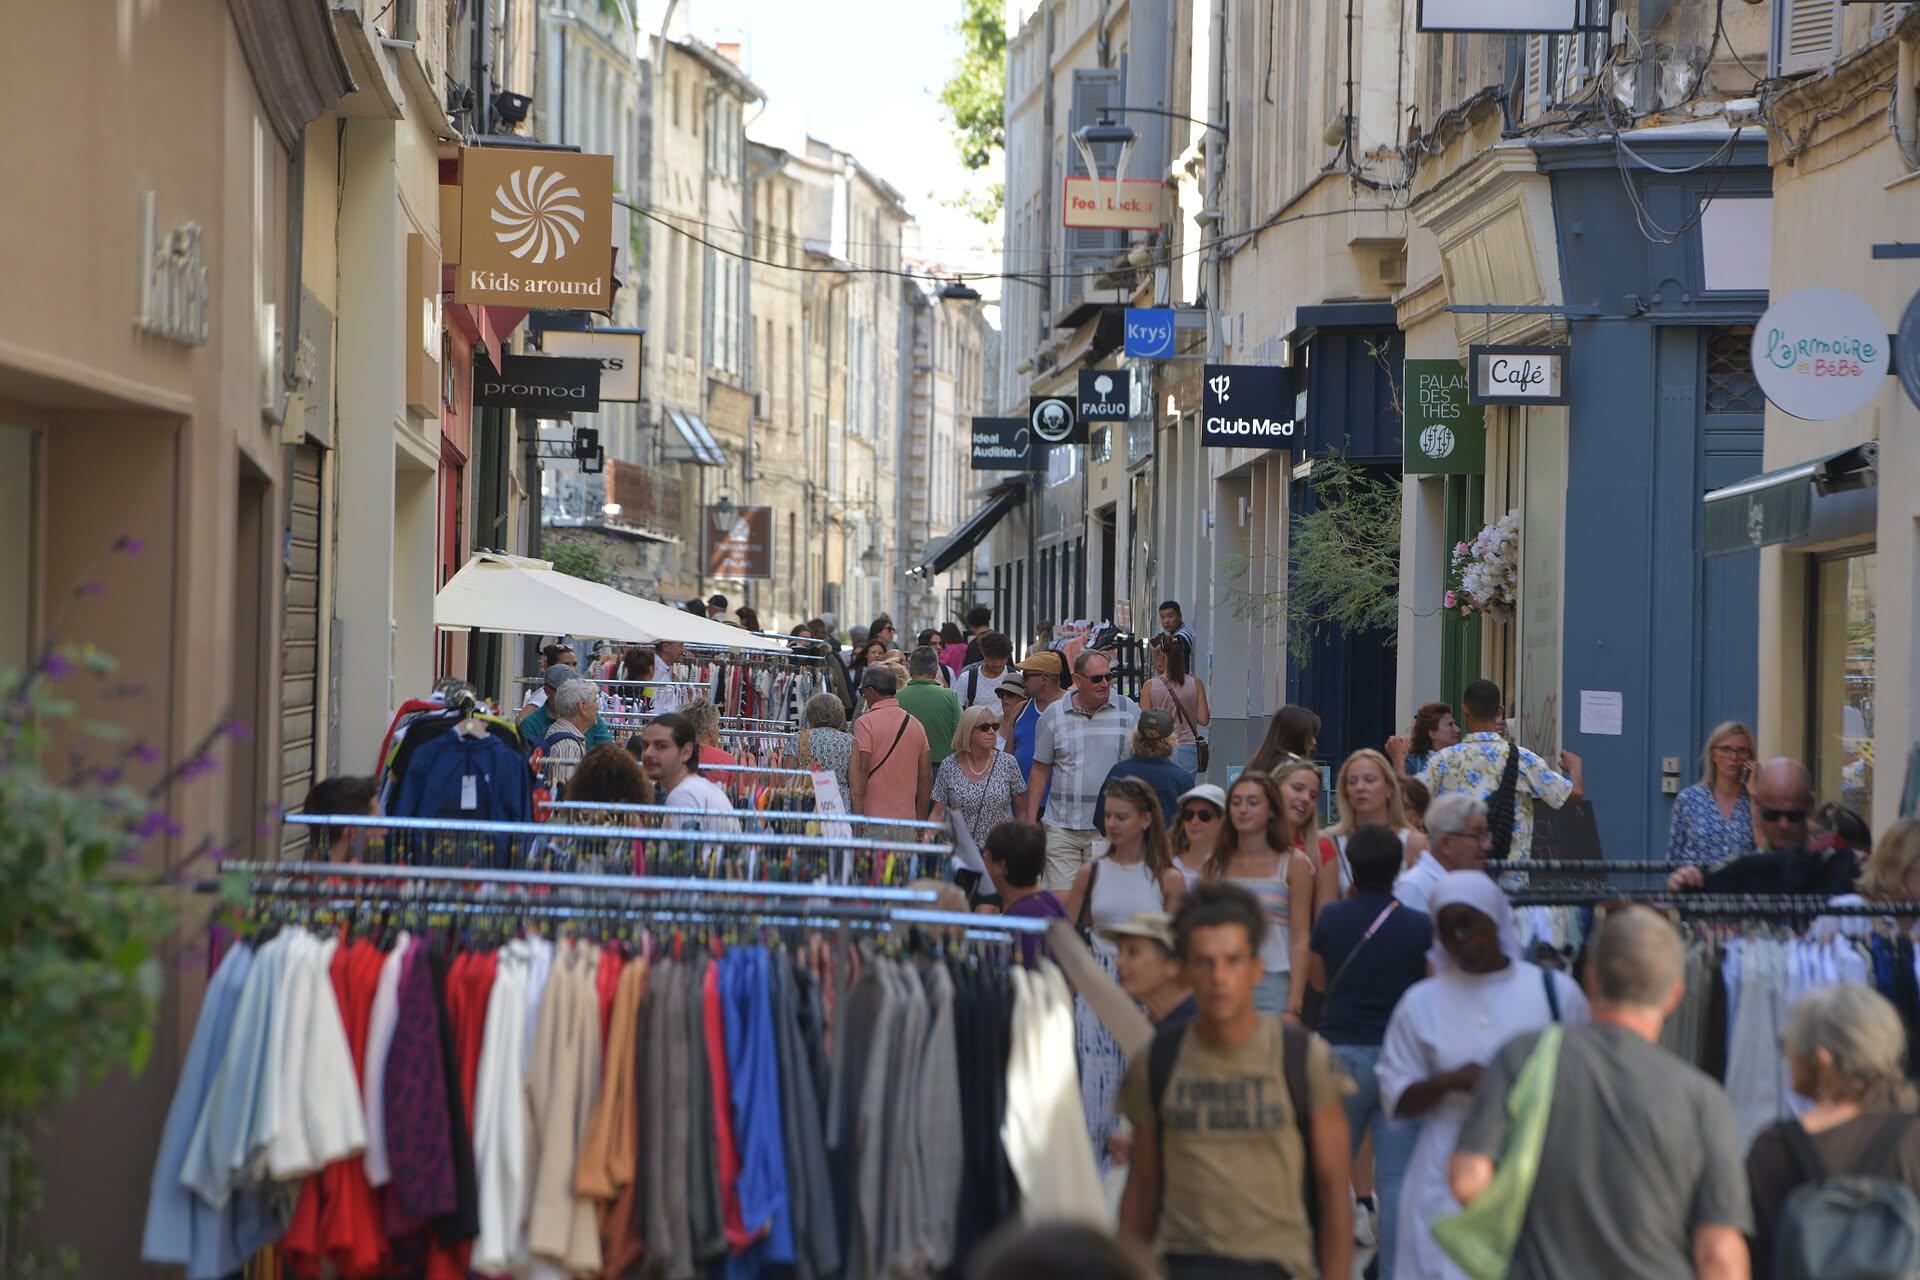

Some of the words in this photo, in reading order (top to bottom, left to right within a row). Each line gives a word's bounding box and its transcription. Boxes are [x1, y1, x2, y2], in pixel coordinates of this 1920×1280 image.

[1072, 197, 1100, 209] Foo
[471, 271, 519, 291] Kids
[525, 277, 601, 295] around
[1128, 324, 1166, 343] Krys
[1492, 359, 1544, 392] Café
[485, 383, 585, 398] promod
[1420, 389, 1451, 404] DES
[1082, 403, 1126, 415] FAGUO
[1206, 417, 1250, 435] Club
[1252, 418, 1294, 436] Med
[973, 433, 1000, 444] Ideal
[973, 446, 1016, 458] Audition
